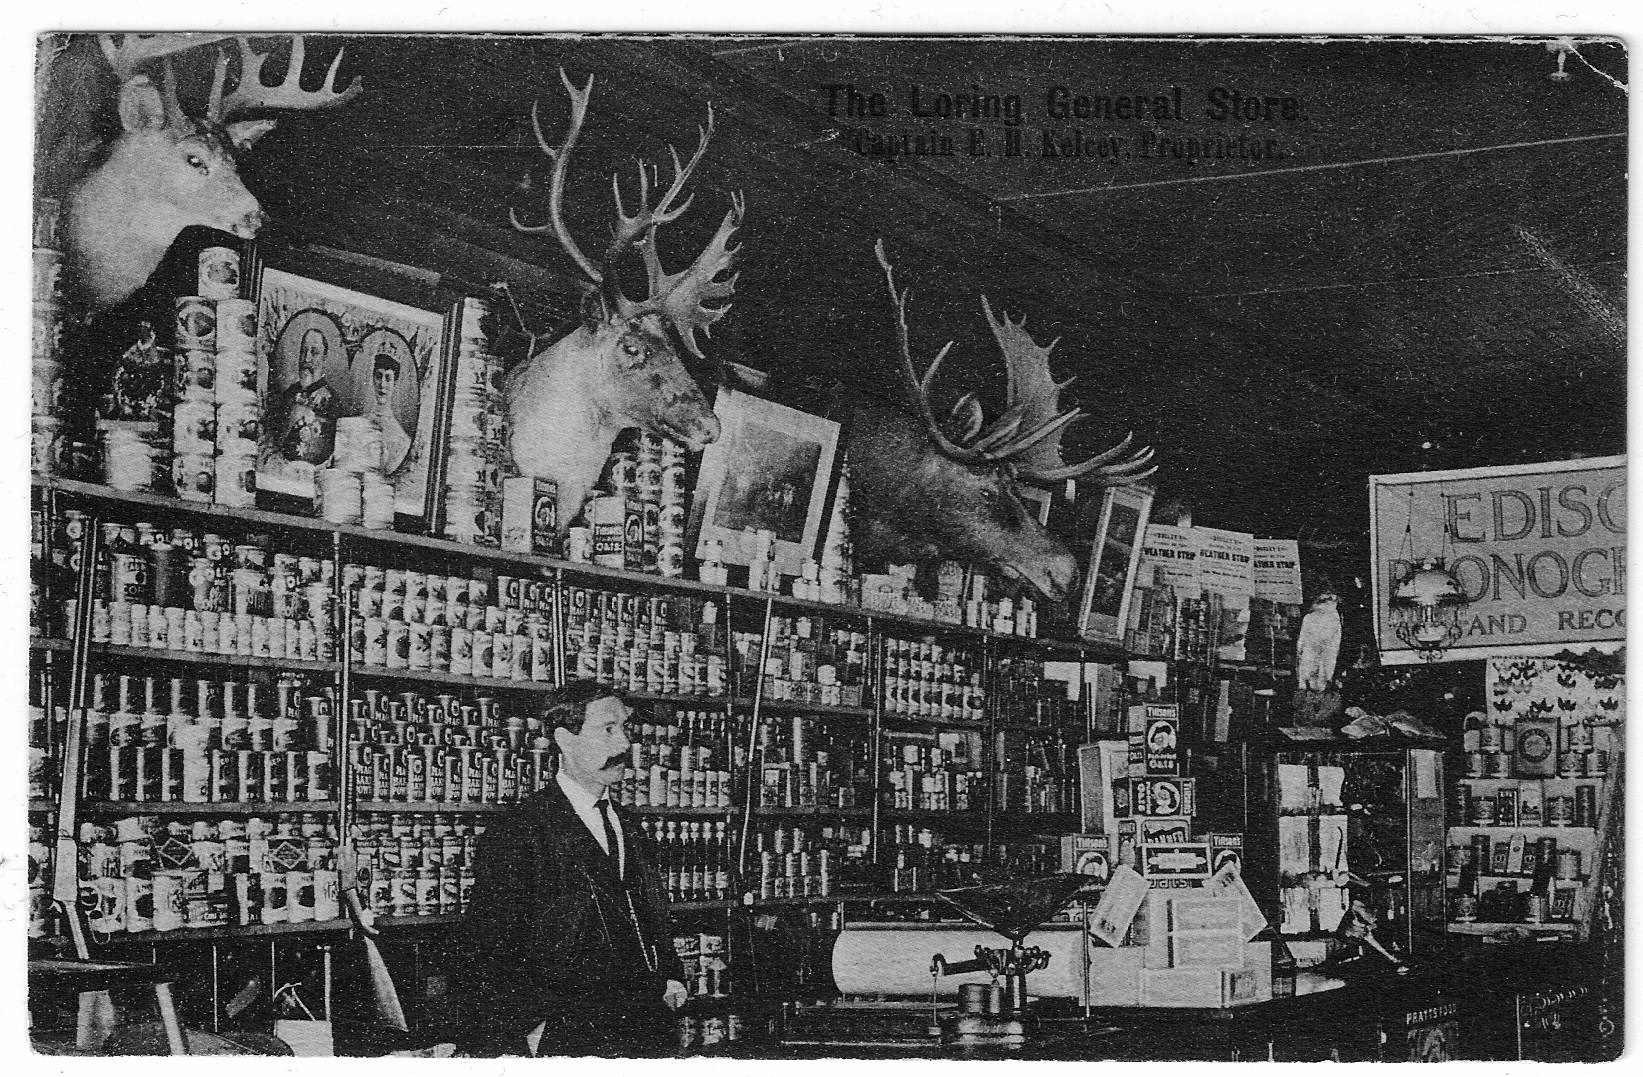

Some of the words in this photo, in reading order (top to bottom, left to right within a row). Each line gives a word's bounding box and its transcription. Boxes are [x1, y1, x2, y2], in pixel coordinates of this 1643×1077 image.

[1177, 550, 1196, 561] STRIP
[1232, 553, 1250, 563] STRIP
[1253, 560, 1275, 569] ATHER
[1276, 560, 1295, 569] STRIP
[1467, 613, 1527, 636] AND
